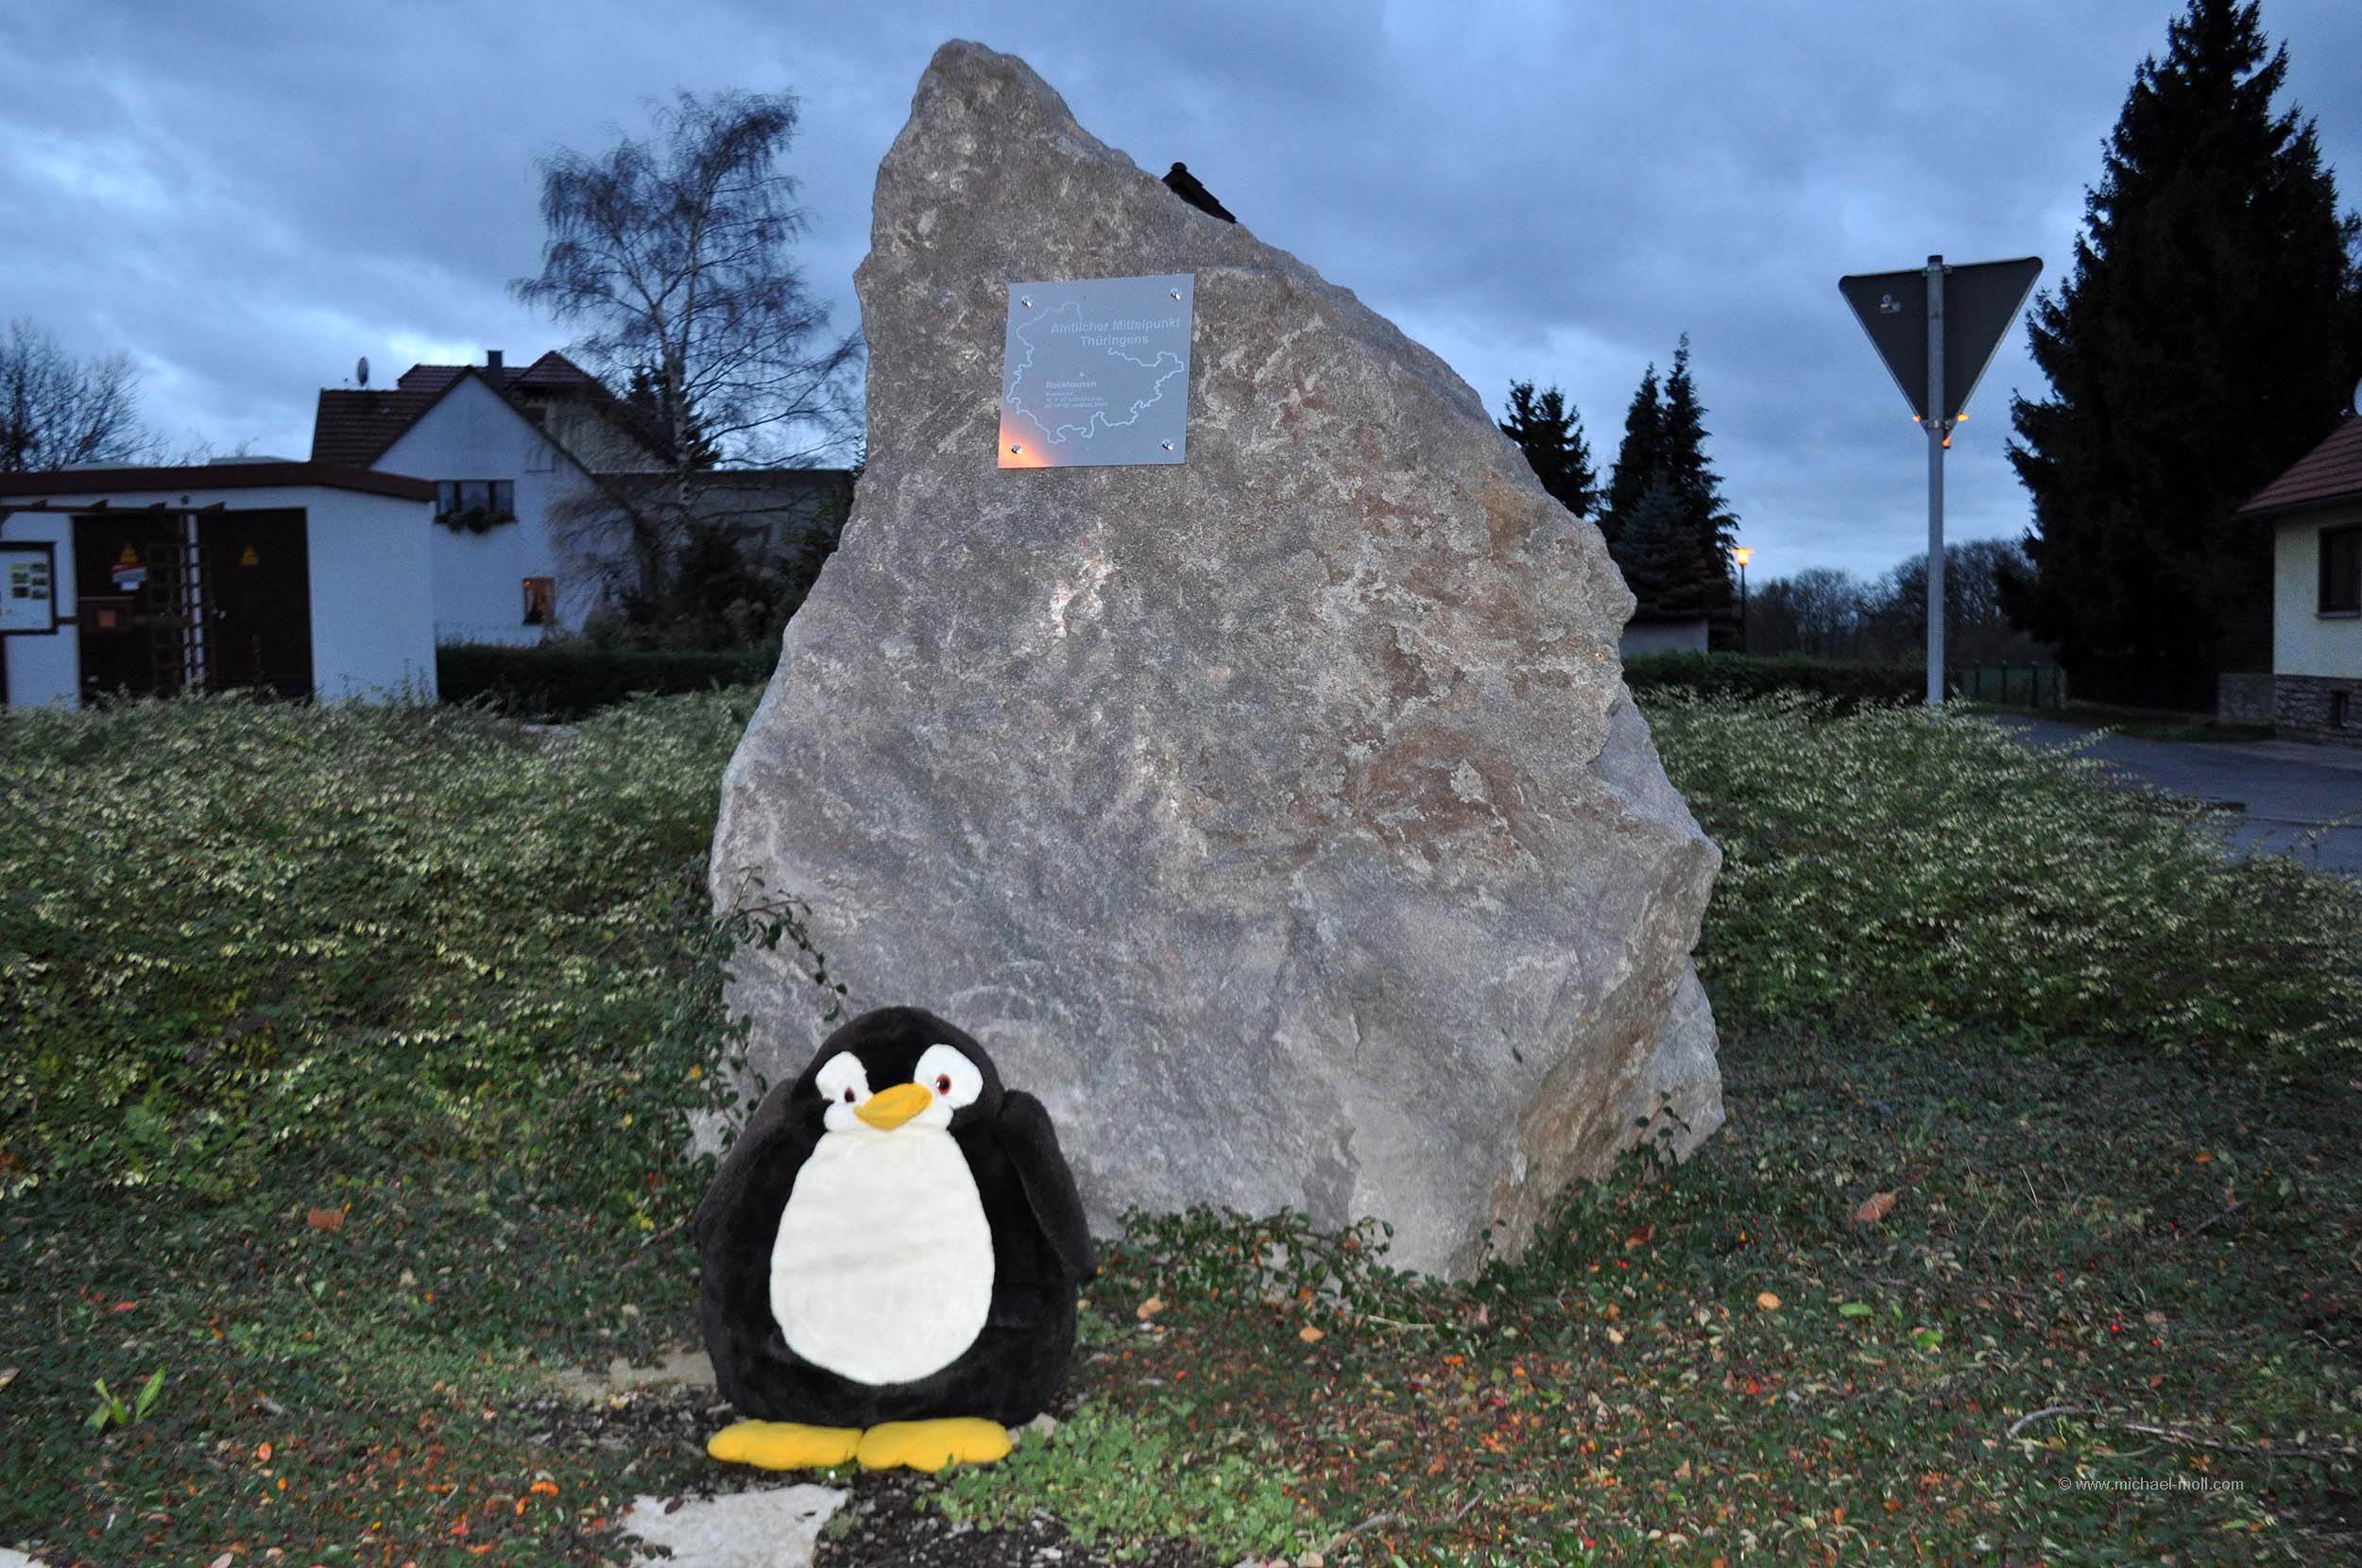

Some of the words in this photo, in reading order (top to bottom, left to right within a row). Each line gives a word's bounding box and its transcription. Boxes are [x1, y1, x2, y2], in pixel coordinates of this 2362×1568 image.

[1051, 321, 1108, 333] Amtlicher
[1112, 317, 1180, 332] Mittelpunkt
[1080, 334, 1149, 348] Thüringens
